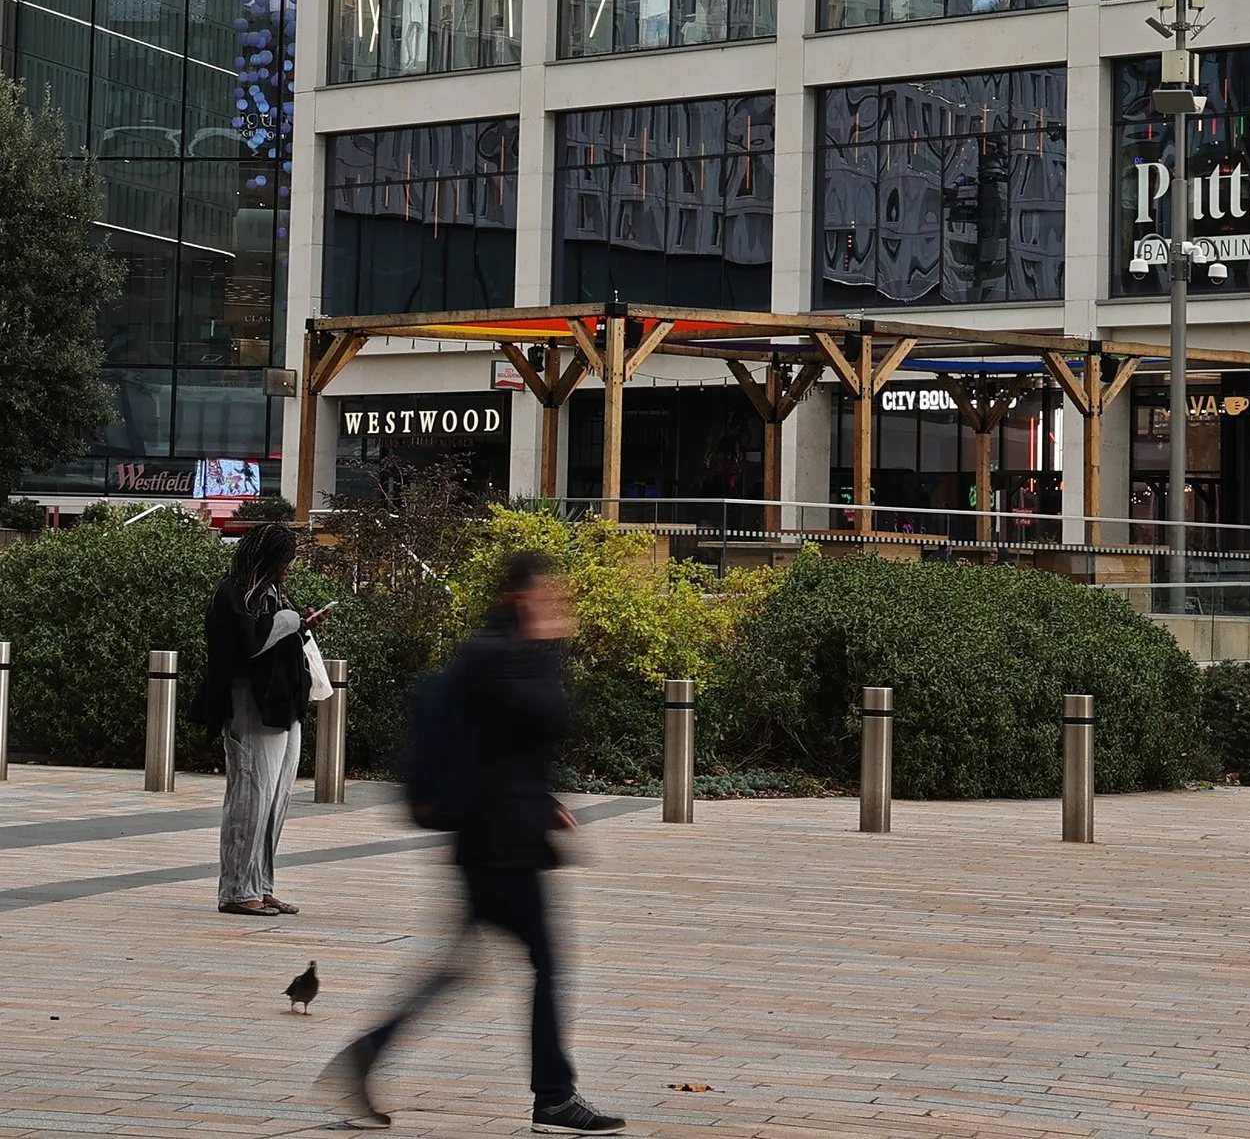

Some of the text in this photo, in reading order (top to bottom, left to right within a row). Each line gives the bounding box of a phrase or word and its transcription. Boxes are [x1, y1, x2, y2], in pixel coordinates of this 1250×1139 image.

[1143, 242, 1171, 261] BA
[882, 390, 916, 411] CITY
[344, 409, 500, 435] WESTWOOD
[115, 462, 193, 492] Westfield
